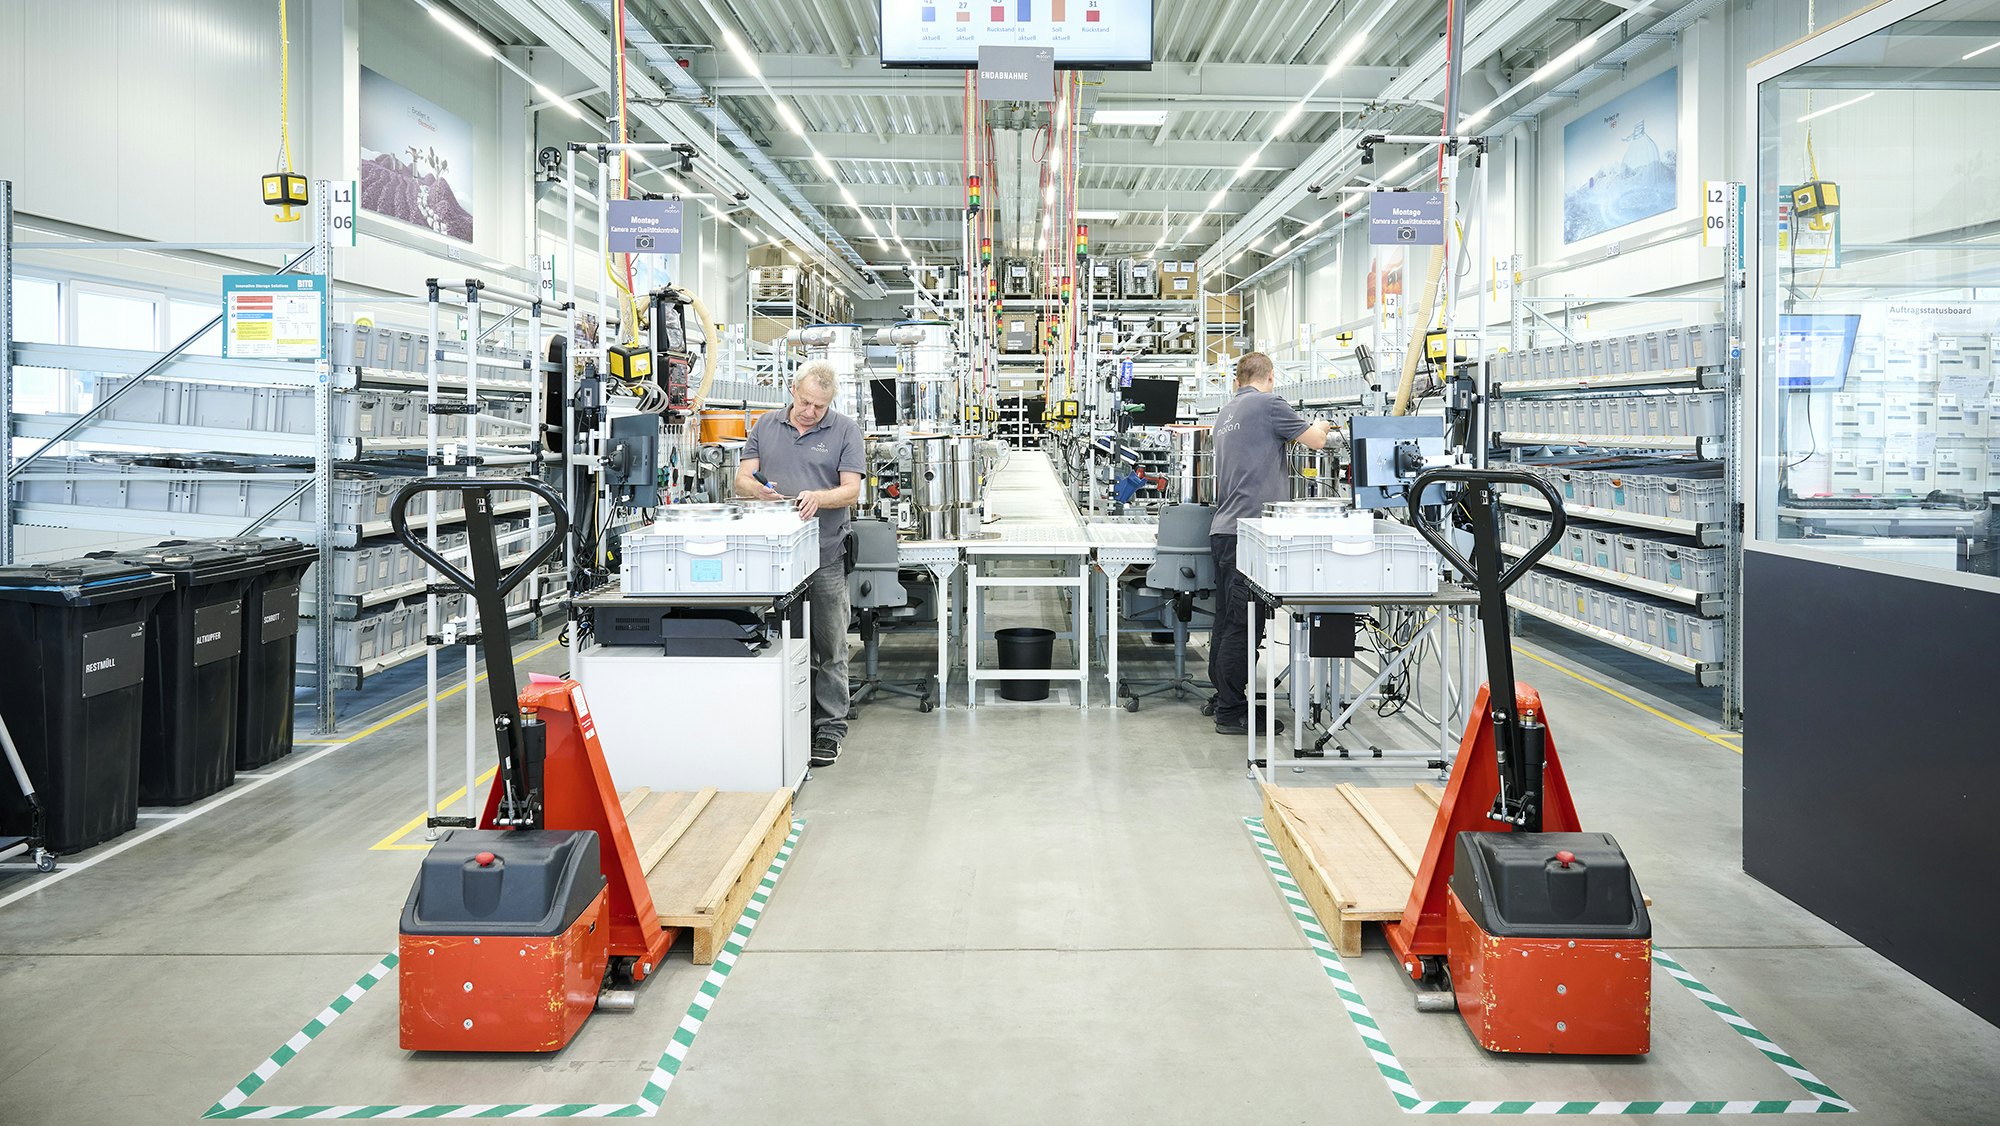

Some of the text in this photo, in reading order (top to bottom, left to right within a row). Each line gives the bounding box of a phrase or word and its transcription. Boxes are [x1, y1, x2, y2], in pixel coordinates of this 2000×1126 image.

[981, 71, 1028, 80] ENDABNAHME
[335, 190, 351, 202] L1
[1708, 190, 1723, 202] L2
[1392, 208, 1422, 217] Montage
[334, 216, 352, 229] 06
[630, 216, 660, 226] Montage
[1706, 216, 1724, 228] 06
[542, 261, 552, 270] L1
[1496, 262, 1508, 270] L2
[542, 280, 552, 288] 05
[1496, 280, 1508, 289] 05
[1890, 306, 1972, 315] Auftragsstatusboard
[196, 632, 222, 645] ALTKUPFER
[86, 658, 116, 674] RESTMÜLL
